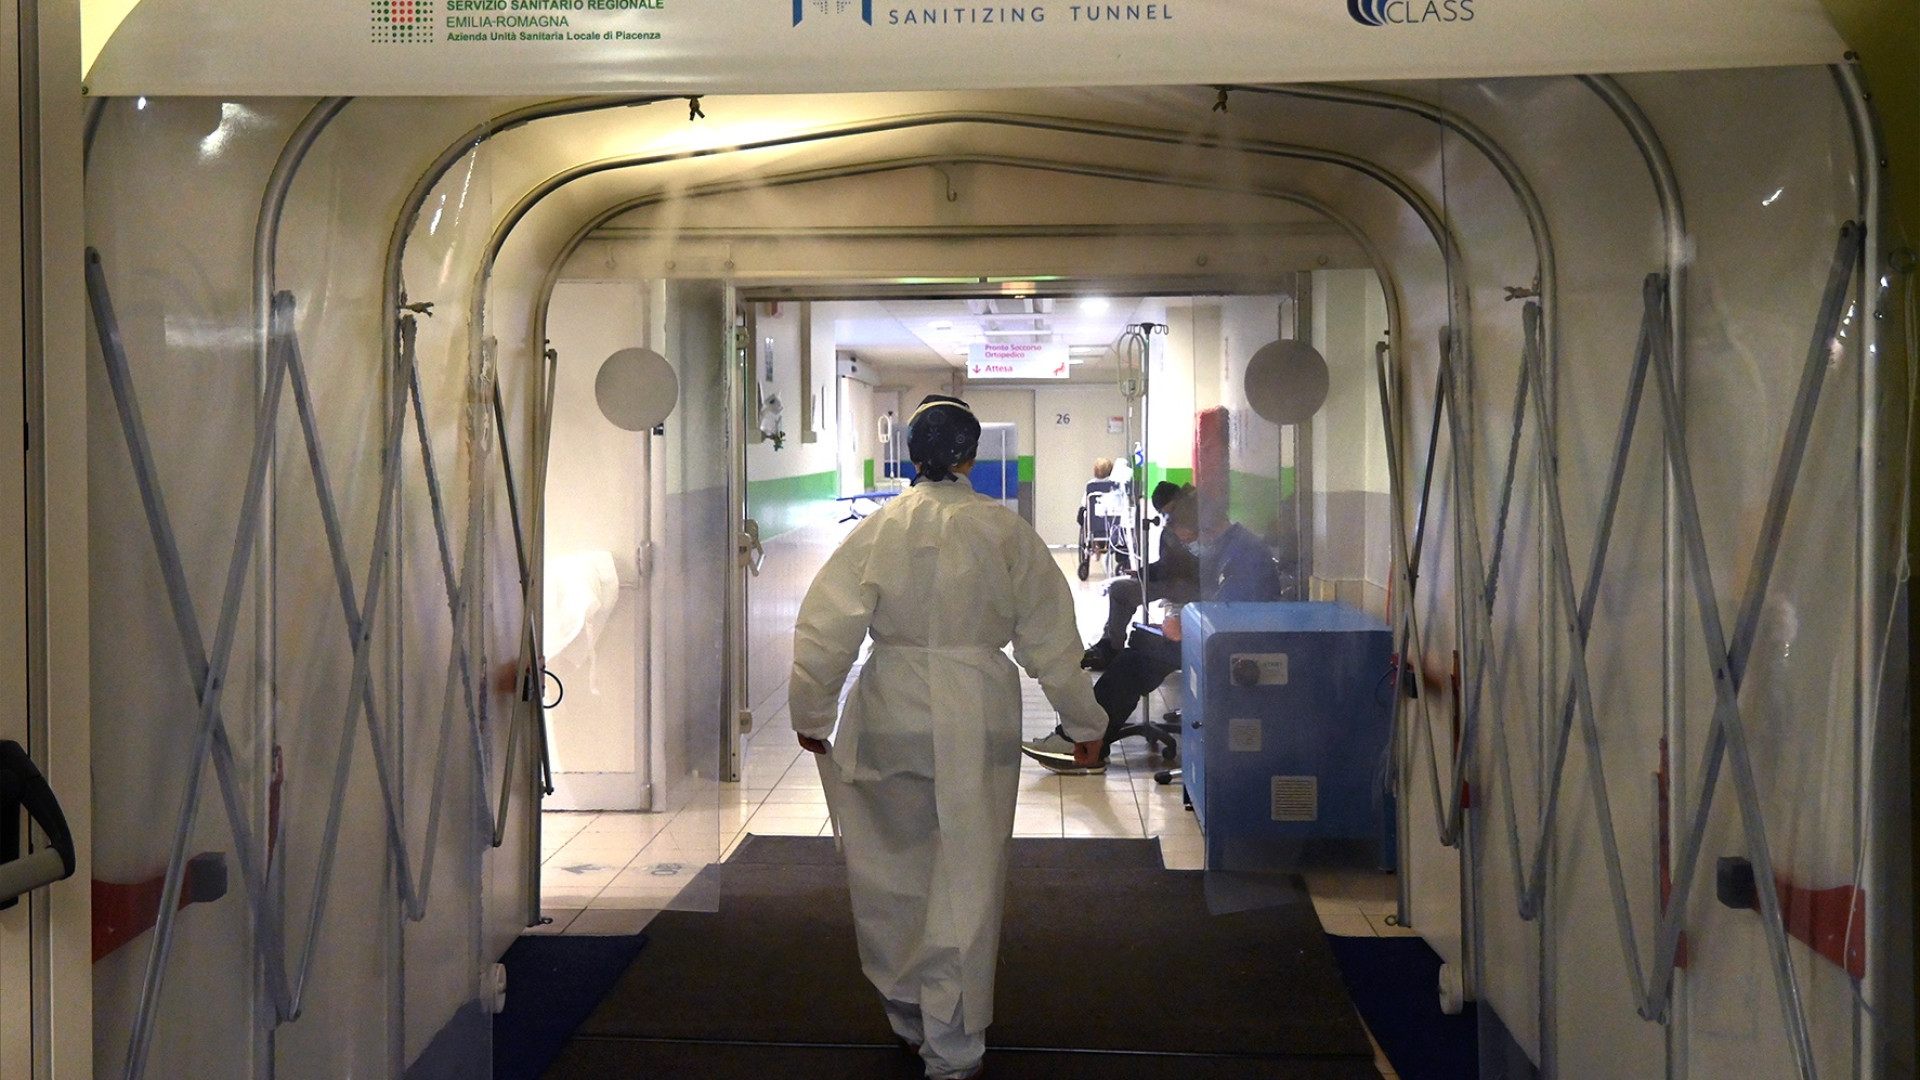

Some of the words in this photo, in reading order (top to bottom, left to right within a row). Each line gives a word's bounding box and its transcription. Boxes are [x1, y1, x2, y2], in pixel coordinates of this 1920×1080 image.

[446, 0, 507, 11] SERVIZIO
[511, 0, 584, 11] SANITARIO
[588, 0, 664, 10] REGIONALE
[888, 7, 1046, 25] SANITIZING
[1069, 4, 1173, 21] TUNNEL
[1386, 0, 1475, 23] CLASS
[446, 15, 569, 28] EMILIA-ROMAGNA
[447, 32, 487, 41] Azienda
[490, 32, 516, 41] Unità
[520, 32, 563, 41] Sanitaria
[567, 32, 601, 41] Locale
[603, 31, 613, 41] di
[616, 31, 661, 41] Piacenza
[984, 351, 1025, 359] Ortopedico
[985, 364, 1014, 373] Attesa
[1056, 413, 1071, 425] 26
